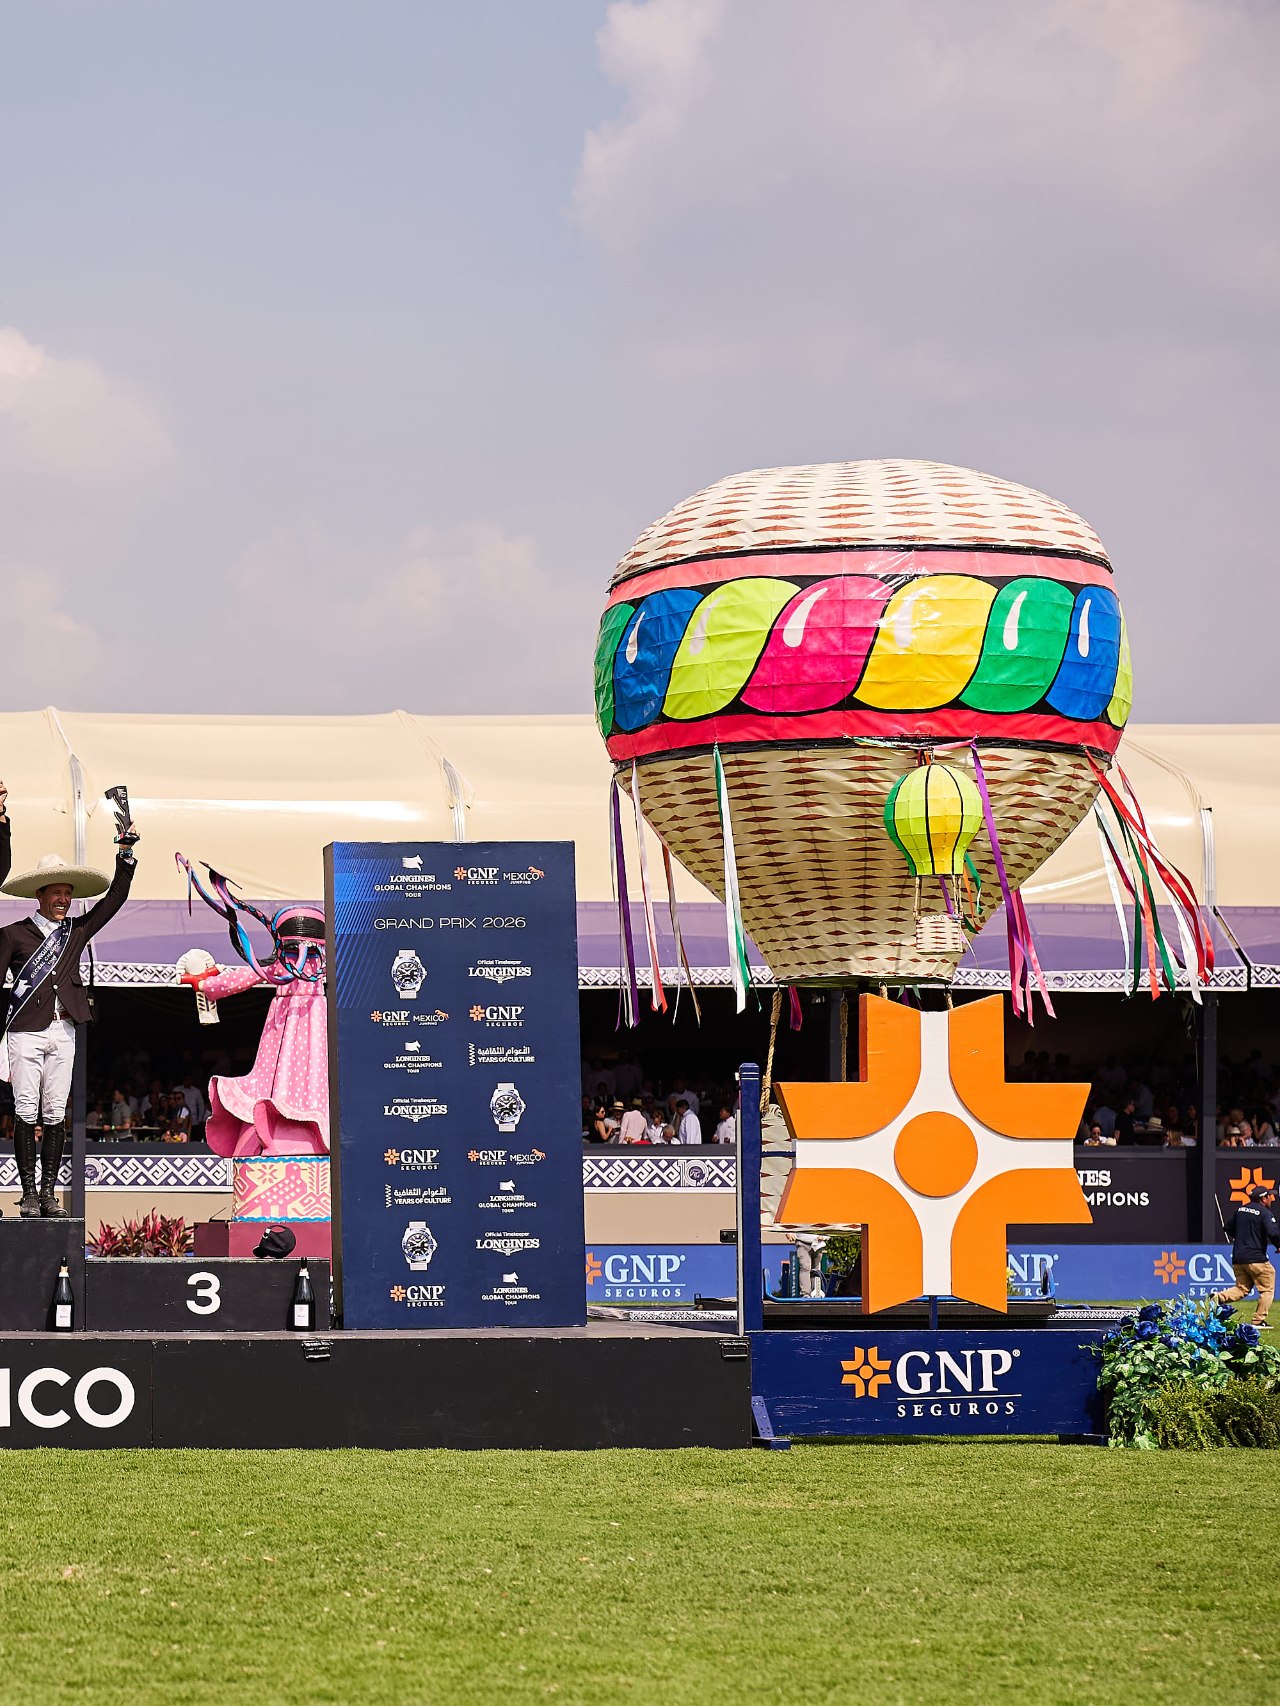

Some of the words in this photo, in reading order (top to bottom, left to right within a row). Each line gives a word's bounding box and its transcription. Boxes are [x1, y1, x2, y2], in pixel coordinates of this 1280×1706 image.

[468, 868, 499, 878] GNP
[374, 918, 434, 929] GRAND
[439, 918, 476, 928] PRIX
[483, 917, 526, 928] 2026
[469, 967, 532, 976] LONGINES
[383, 1011, 410, 1021] GNP
[486, 1006, 524, 1019] GNP
[384, 1105, 447, 1115] LONGINES
[401, 1150, 439, 1163] GNP
[479, 1151, 507, 1160] GNP
[1083, 1192, 1150, 1206] MPIONS
[476, 1239, 539, 1249] LONGINES
[1008, 1254, 1054, 1281] NP
[1188, 1254, 1237, 1282] GN
[186, 1271, 220, 1316] 3
[407, 1286, 445, 1299] GNP
[605, 1289, 680, 1297] SEGUROS
[897, 1402, 1015, 1417] SEGUROS
